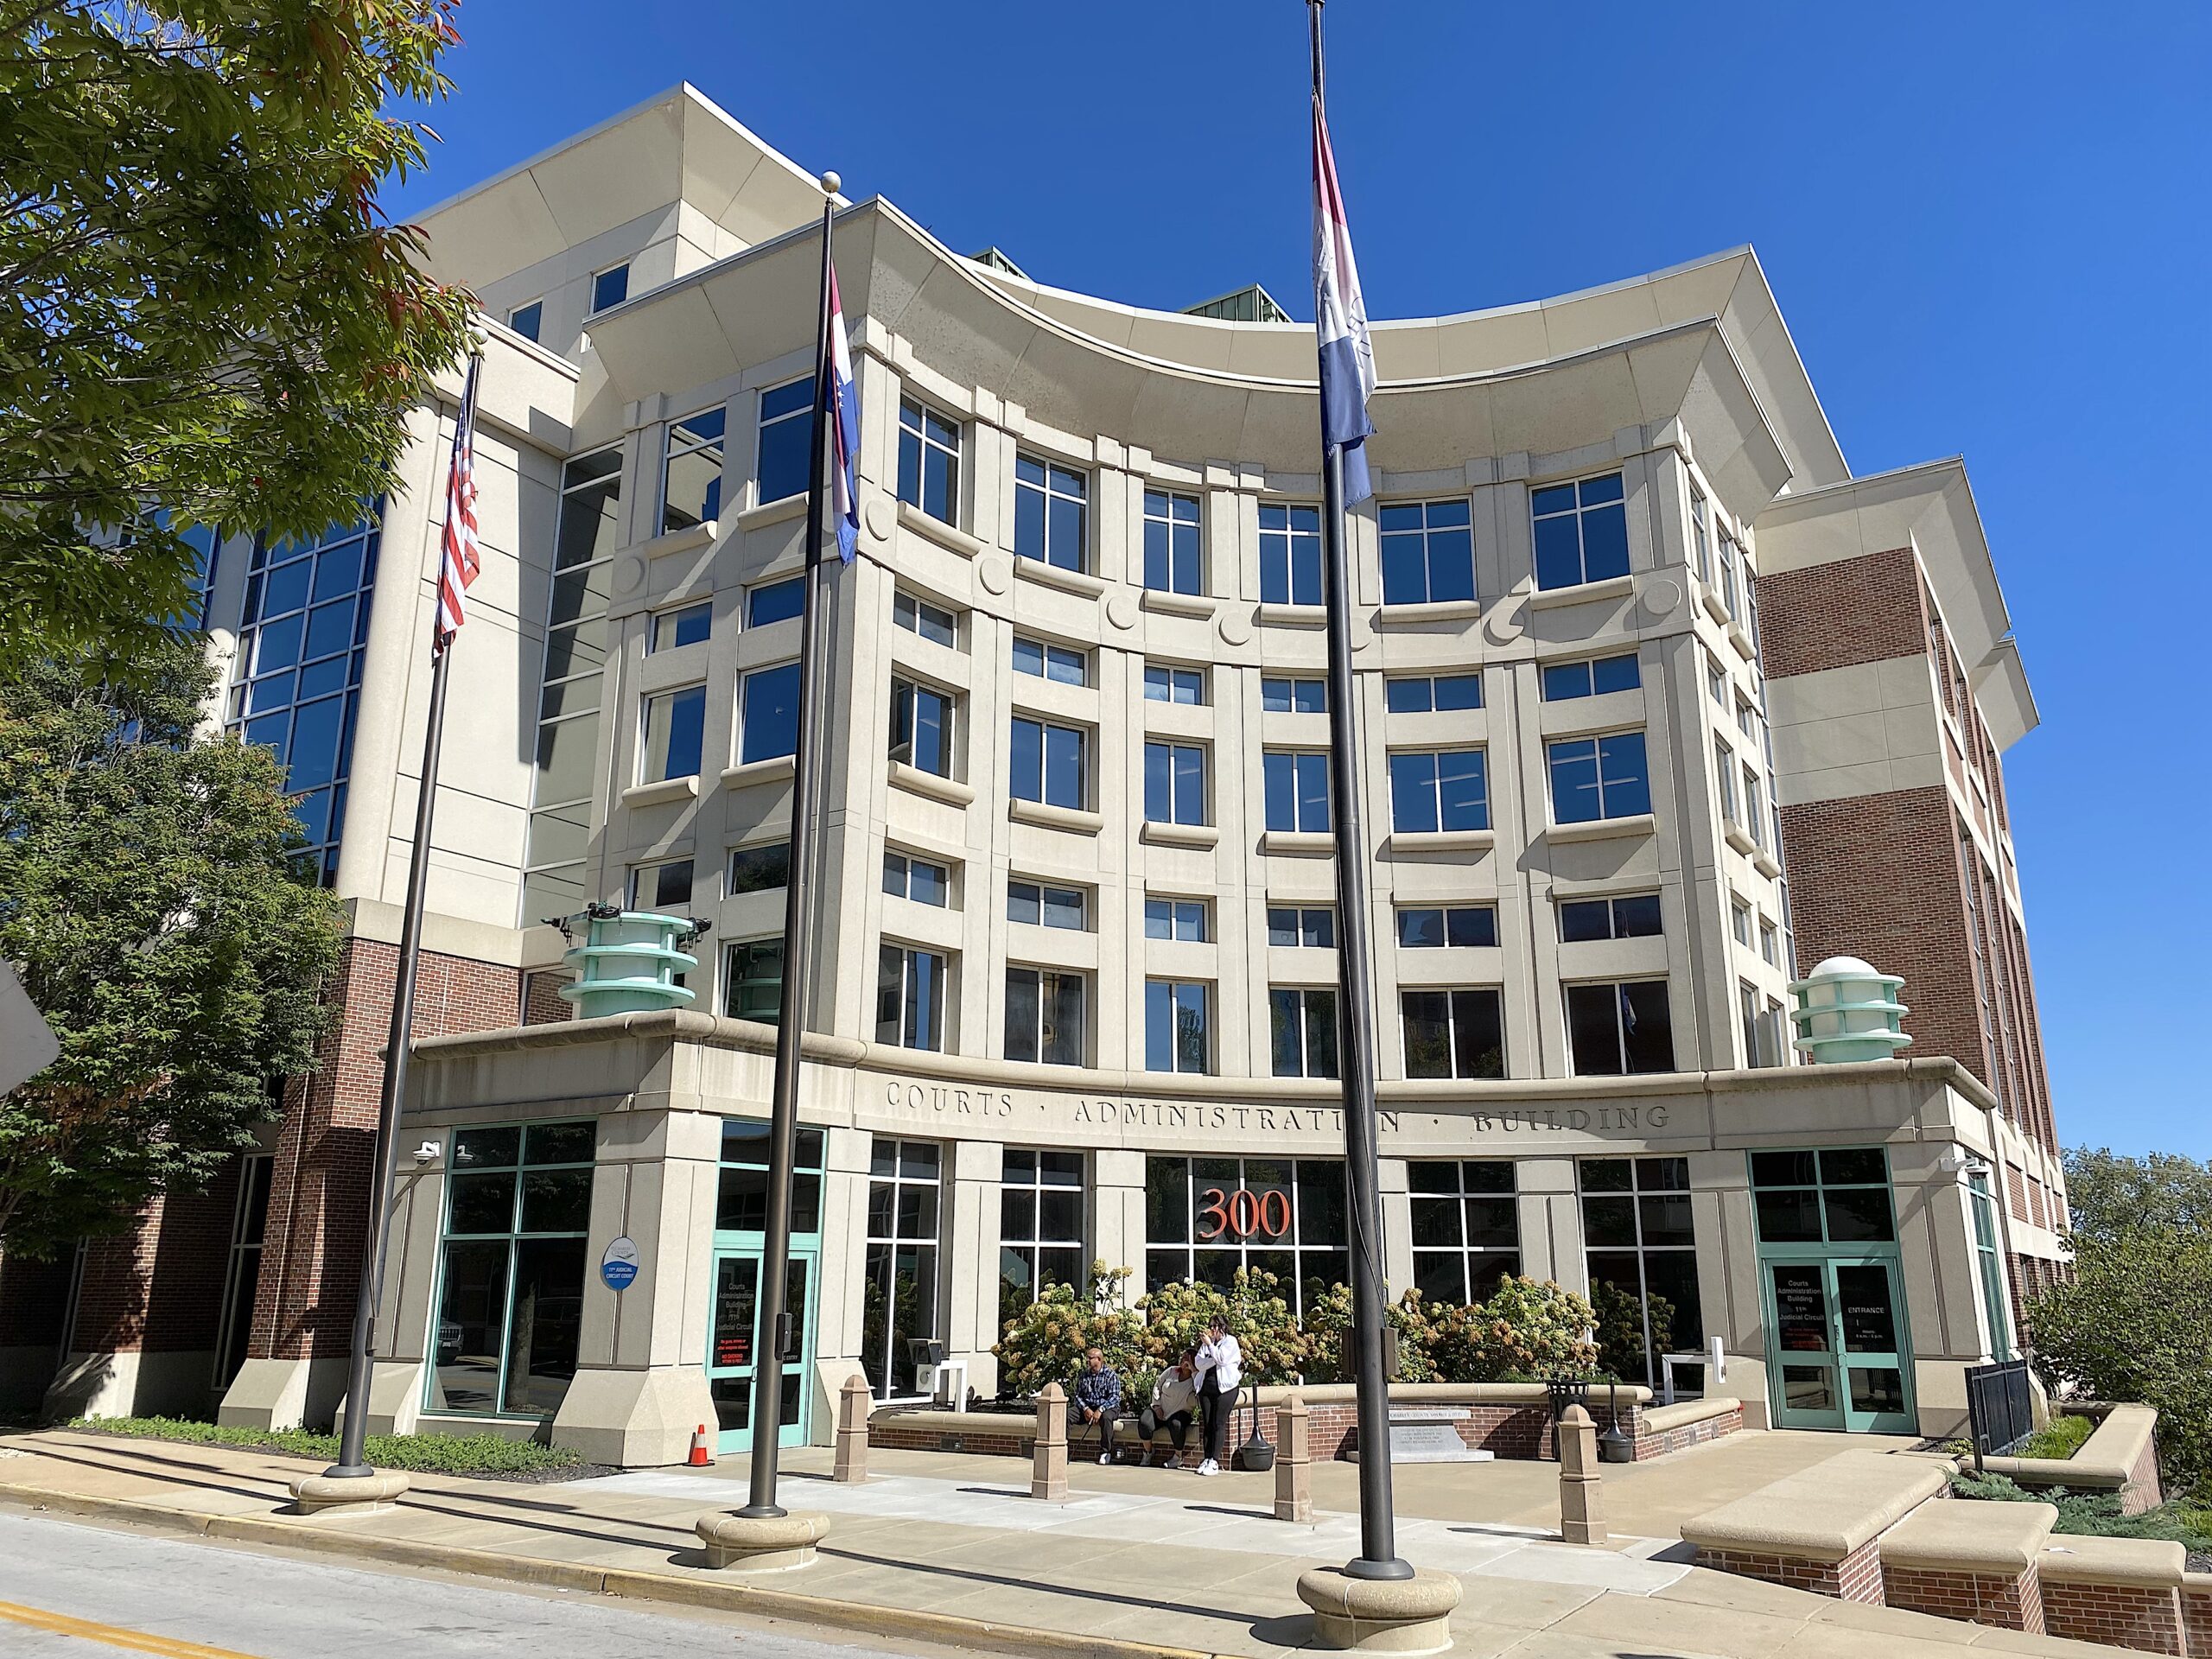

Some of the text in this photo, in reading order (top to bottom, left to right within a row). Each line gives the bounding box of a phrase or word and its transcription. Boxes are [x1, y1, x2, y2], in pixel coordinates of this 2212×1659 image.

[887, 1082, 1669, 1133] COURTS ADMINISTRATIN BUILDING
[1198, 1187, 1291, 1238] 300
